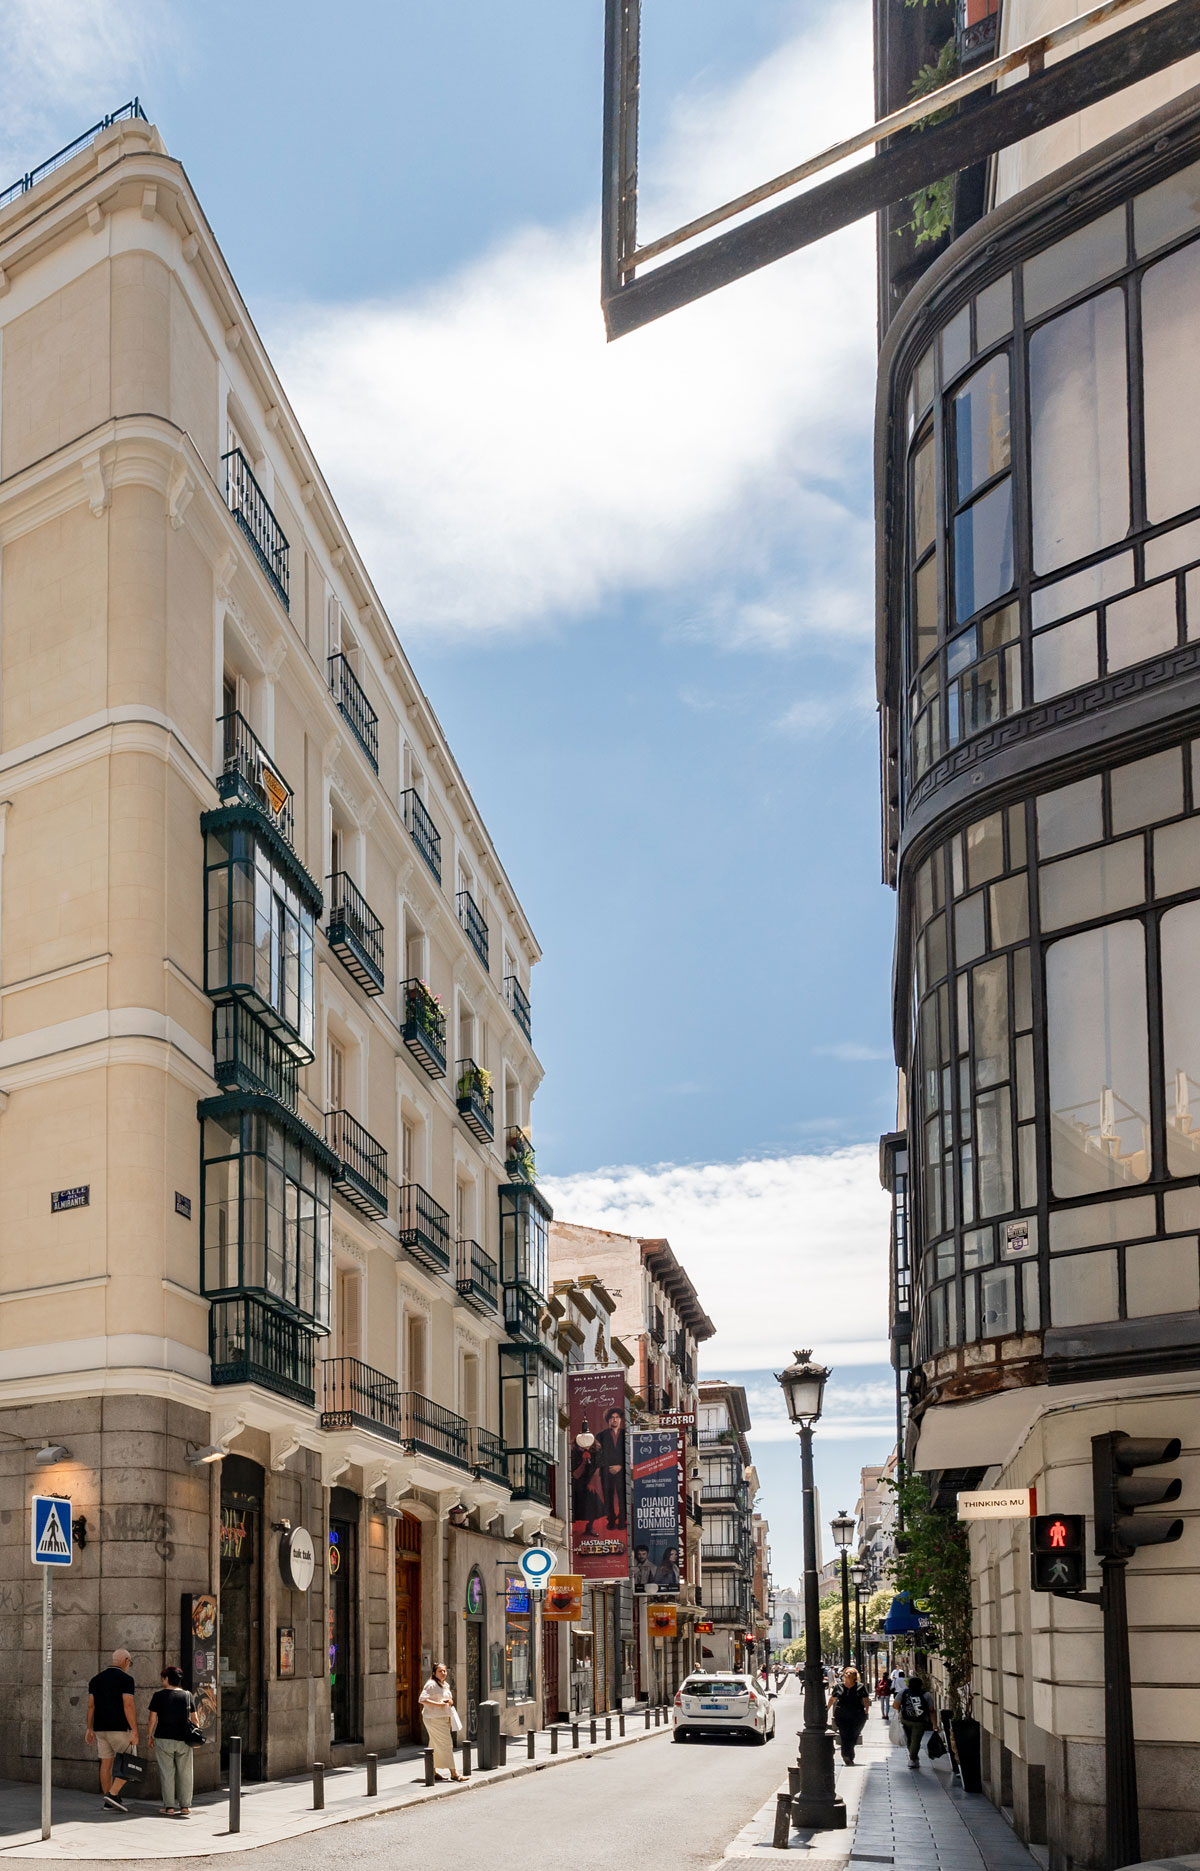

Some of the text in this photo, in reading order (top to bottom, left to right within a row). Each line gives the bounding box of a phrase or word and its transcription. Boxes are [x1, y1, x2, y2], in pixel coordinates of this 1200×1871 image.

[60, 1188, 86, 1197] CALLE
[53, 1197, 86, 1211] ALMIRANTE
[660, 1415, 695, 1425] TEATRO
[641, 1496, 675, 1508] CUANDO
[964, 1500, 1008, 1508] THINKING
[636, 1507, 676, 1519] DUERME
[637, 1518, 677, 1530] CONMIGO
[293, 1548, 312, 1560] tuk tuk
[581, 1545, 624, 1554] FIESTA
